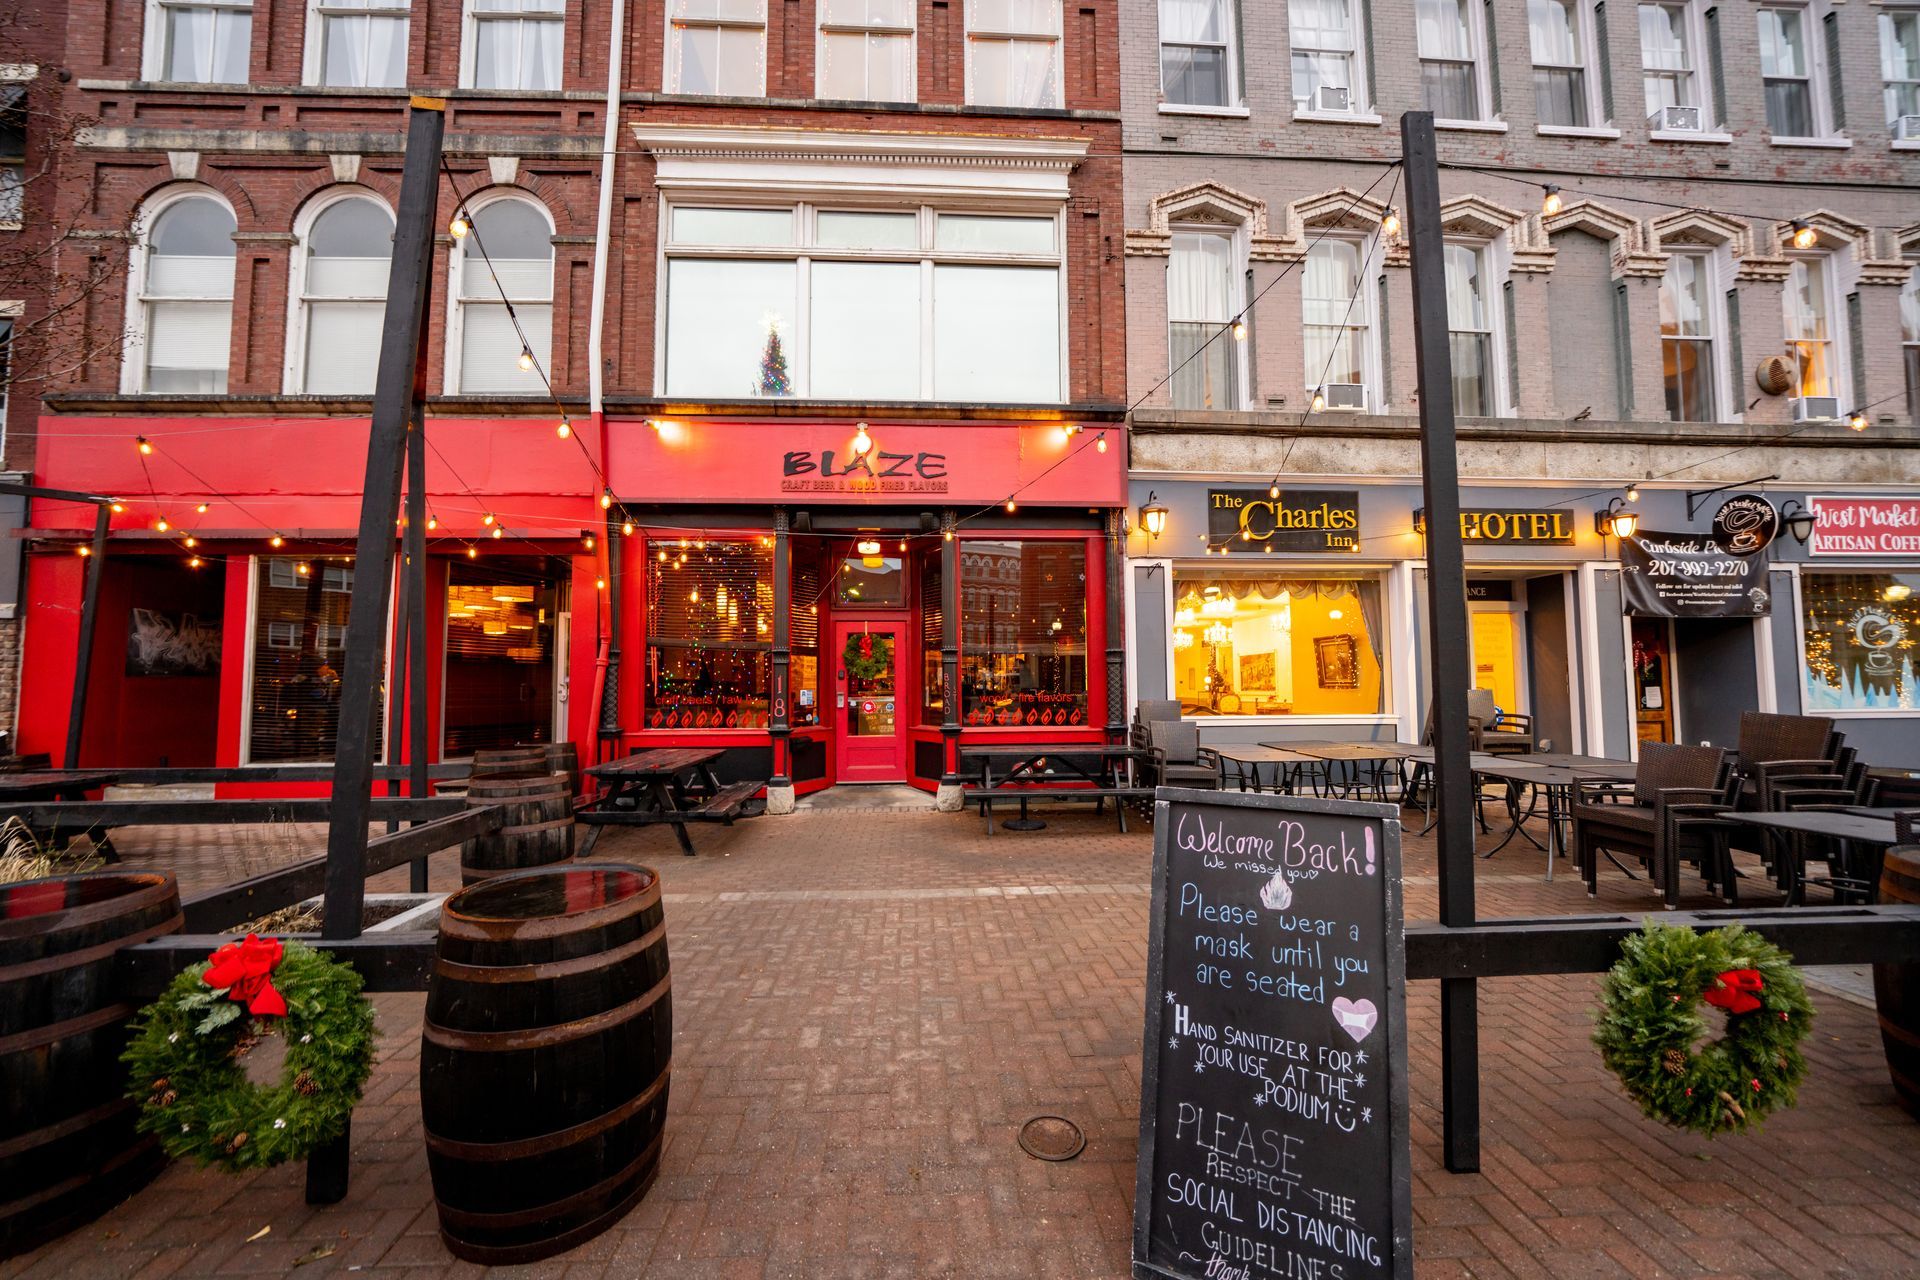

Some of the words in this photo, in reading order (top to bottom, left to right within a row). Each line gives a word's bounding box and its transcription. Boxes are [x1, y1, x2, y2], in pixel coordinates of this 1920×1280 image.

[783, 449, 948, 480] BLAZE
[781, 479, 811, 491] CRAFT
[813, 479, 836, 491] BEER
[849, 480, 877, 491] WOOD
[880, 480, 906, 491] FIRED
[908, 480, 949, 491] FLAVORS
[1211, 493, 1243, 508] The
[1238, 500, 1358, 541] Charles
[1459, 512, 1573, 540] HOTEL
[1811, 503, 1858, 528] West
[1858, 503, 1919, 528] Market
[1324, 532, 1353, 547] Inn
[1639, 539, 1701, 555] Curbside
[1814, 533, 1877, 550] ARTISAN
[1647, 559, 1750, 577] 207-992-2270
[1466, 587, 1487, 597] ANCE
[682, 693, 713, 705] beers
[722, 694, 743, 705] raw
[943, 672, 951, 715] BROAD
[1037, 692, 1073, 703] flavors
[1177, 812, 1275, 862] Welcome
[1278, 820, 1376, 877] Back!
[1203, 853, 1228, 869] We
[1234, 859, 1283, 877] missed
[1286, 868, 1309, 884] you
[1179, 882, 1259, 927] Please
[1279, 914, 1337, 937] wear
[1349, 923, 1359, 942] a
[1194, 932, 1254, 960] mask
[1271, 937, 1323, 970] until
[1333, 955, 1369, 987] you
[1196, 962, 1233, 989] are
[1245, 970, 1325, 1005] seated
[1174, 1002, 1218, 1041] HAND
[1223, 1025, 1310, 1063] SANITIZER
[1318, 1045, 1353, 1075] FOR
[1196, 1041, 1235, 1072] YOUR
[1238, 1051, 1272, 1081] USE
[1281, 1063, 1310, 1090] AT
[1315, 1070, 1356, 1105] THE
[1264, 1078, 1330, 1125] PODIUM
[1175, 1101, 1305, 1179] PLEASE
[1206, 1152, 1300, 1200] RESPECT
[1312, 1187, 1357, 1222] THE
[1166, 1172, 1244, 1223] SOCIAL
[1257, 1200, 1382, 1268] DISTANCING
